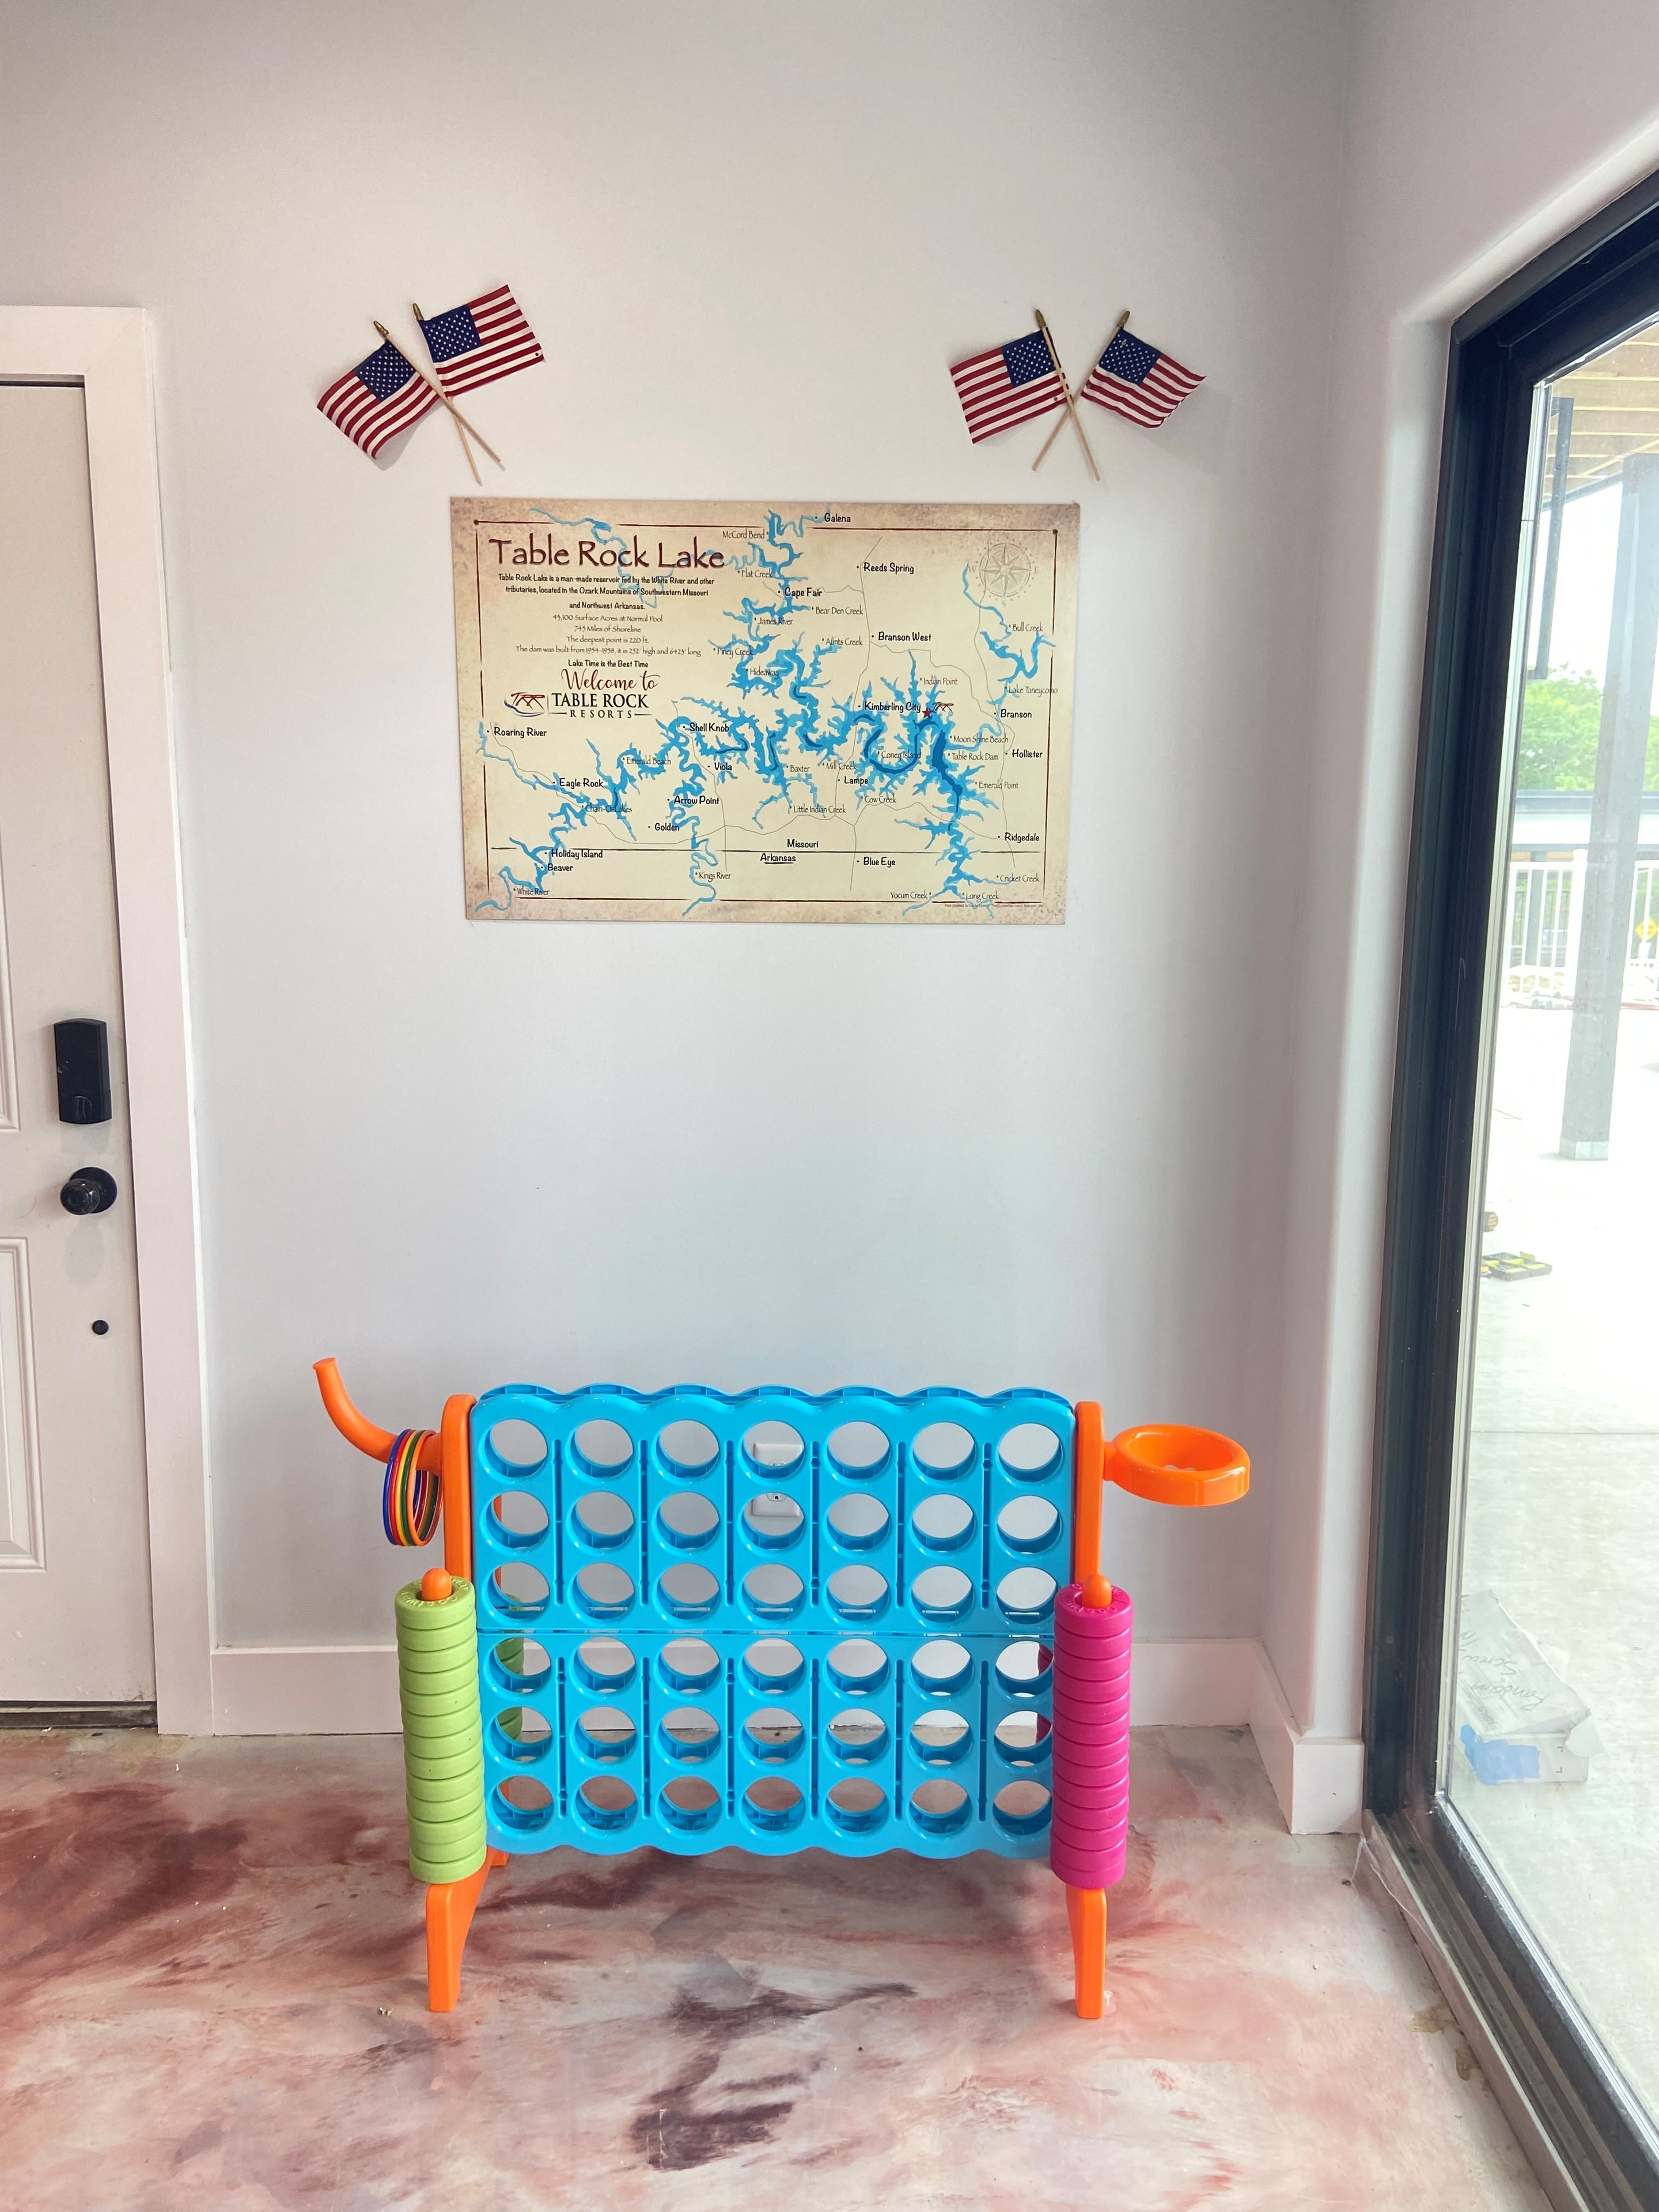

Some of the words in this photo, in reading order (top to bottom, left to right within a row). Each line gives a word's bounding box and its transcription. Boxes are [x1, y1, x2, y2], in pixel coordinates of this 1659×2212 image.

[824, 513, 851, 522] Galena
[722, 529, 747, 539] McCord
[749, 529, 765, 539] Bend
[488, 532, 570, 565] Table
[578, 535, 649, 567] Rock
[658, 536, 724, 568] Lake
[741, 568, 753, 577] Flat
[754, 569, 772, 578] Creek
[864, 562, 888, 572] Reeds
[889, 563, 914, 575] Spring
[498, 573, 514, 581] Table
[632, 577, 639, 586] by
[506, 585, 538, 594] tributaries,
[579, 586, 599, 594] Ozark
[600, 587, 631, 595] Mountains
[785, 587, 804, 599] Cape
[806, 588, 823, 597] Fair
[815, 606, 830, 615] Bear
[831, 606, 844, 615] Den
[845, 605, 863, 615] Creek
[574, 613, 599, 621] Surface
[778, 617, 793, 625] River
[1013, 622, 1024, 632] Bull
[1025, 622, 1043, 632] Creek
[579, 635, 605, 645] deepest
[606, 637, 622, 646] point
[825, 637, 844, 646] Aunts
[844, 635, 863, 646] Creek
[878, 631, 910, 641] Branson
[912, 632, 931, 641] West
[516, 644, 528, 652] The
[642, 647, 656, 656] high
[687, 647, 701, 657] long
[717, 647, 734, 658] Piney
[735, 645, 753, 656] Creek
[750, 666, 779, 676] Hideaway
[561, 668, 637, 691] Welcome
[639, 671, 661, 691] to
[923, 675, 941, 685] Indian
[942, 677, 958, 685] Point
[1008, 684, 1024, 694] Lake
[551, 693, 597, 707] TABLE
[603, 694, 649, 708] ROCK
[865, 701, 904, 713] Kimberling
[906, 702, 921, 713] City
[570, 710, 632, 719] RESORTS
[1000, 709, 1032, 718] Branson
[690, 722, 707, 732] Shell
[709, 722, 729, 732] Knob
[494, 727, 524, 738] Roaring
[527, 727, 547, 737] River
[972, 733, 988, 743] Shine
[990, 733, 1009, 743] Beach
[903, 748, 921, 759] Island
[952, 751, 967, 760] Table
[968, 750, 984, 760] Rock
[1012, 748, 1043, 759] Hollister
[627, 755, 651, 765] Emerald
[652, 755, 671, 765] Beach
[714, 762, 732, 771] Viola
[790, 764, 810, 772] Baxter
[826, 761, 836, 770] Mill
[838, 761, 857, 770] Creek
[559, 778, 581, 791] Eagle
[583, 778, 604, 788] Rock
[844, 776, 869, 786] Lampe
[979, 779, 1003, 789] Emerald
[673, 795, 697, 804] Arrow
[699, 796, 719, 805] Point
[864, 796, 878, 804] Cow
[878, 793, 896, 804] Creek
[793, 804, 808, 813] Little
[809, 804, 827, 813] Indian
[828, 804, 846, 813] Creek
[654, 823, 680, 831] Golden
[1004, 832, 1040, 843] Ridgedale
[787, 839, 819, 848] Missouri
[551, 850, 579, 859] Holiday
[581, 850, 603, 858] Island
[760, 853, 796, 862] Arkansas
[547, 863, 573, 872] Beaver
[863, 857, 879, 866] Blue
[881, 857, 896, 868] Eye
[699, 872, 715, 882] Kings
[1000, 873, 1021, 882] Cricket
[1022, 873, 1040, 882] Creek
[517, 885, 533, 895] White
[535, 887, 550, 895] River
[910, 889, 928, 899] Creek
[965, 892, 981, 902] Long
[982, 889, 999, 900] Creek
